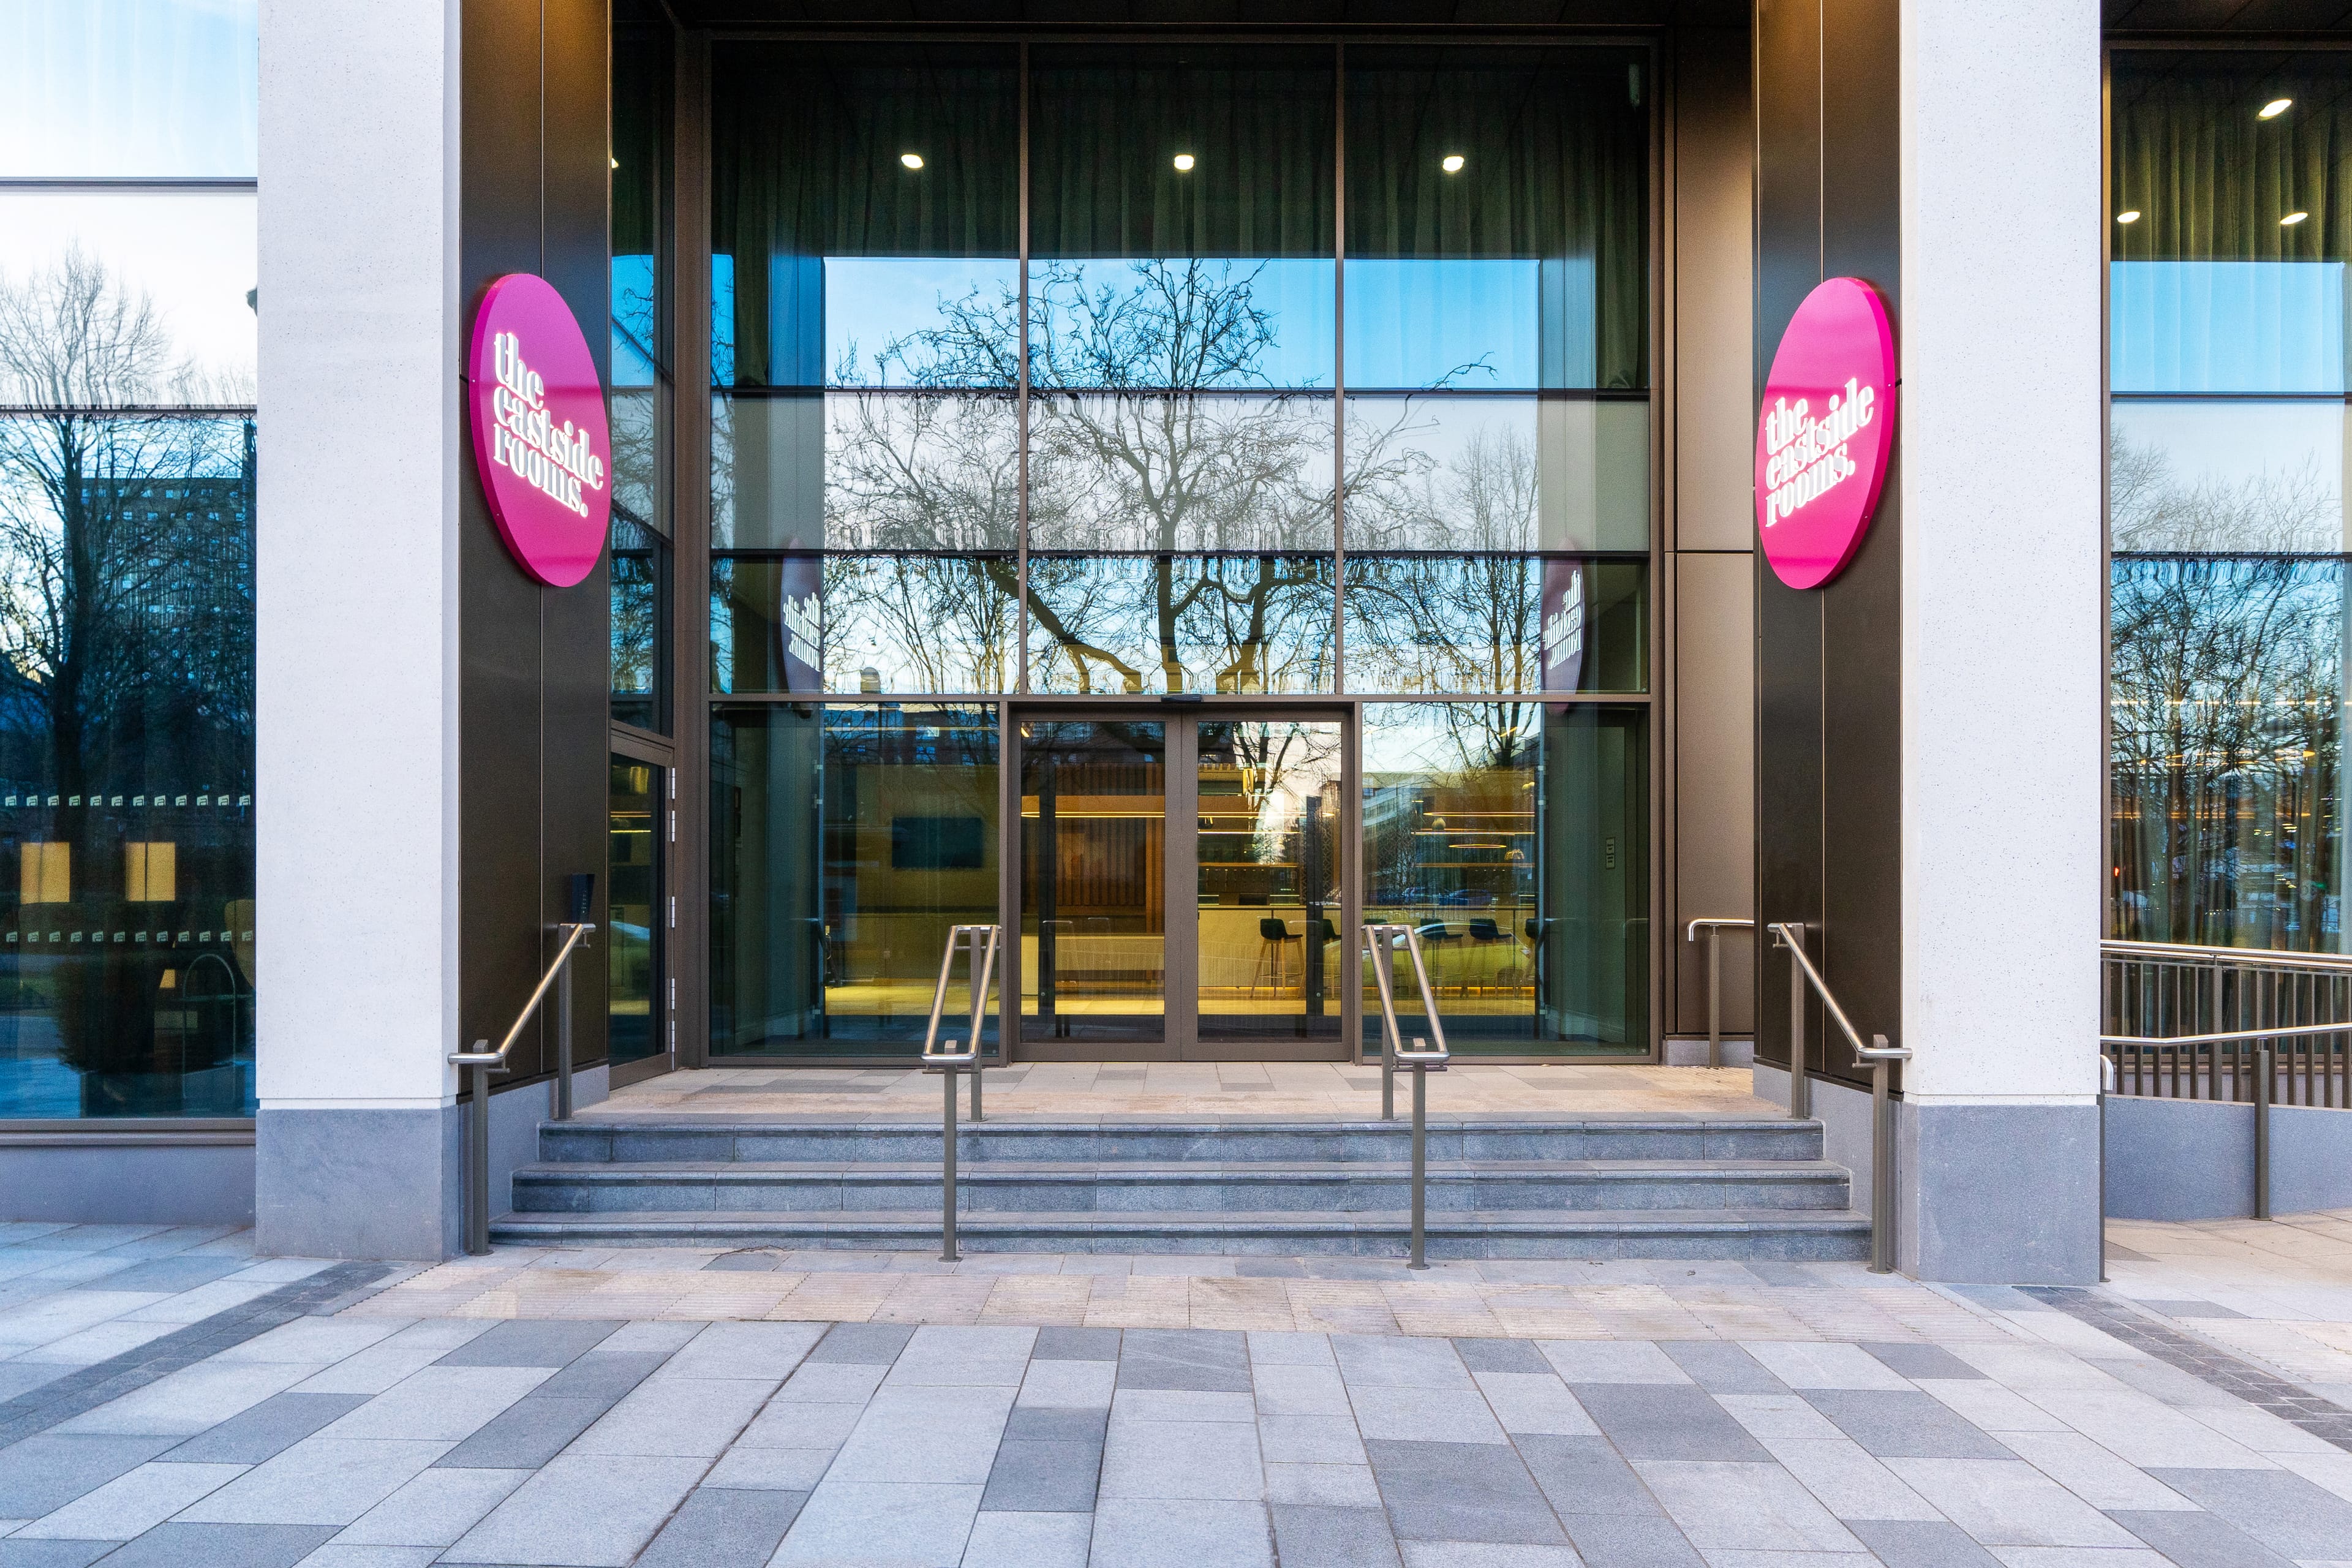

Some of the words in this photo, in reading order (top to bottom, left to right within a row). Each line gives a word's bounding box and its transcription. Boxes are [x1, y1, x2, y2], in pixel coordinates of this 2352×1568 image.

[494, 333, 545, 410] the
[493, 386, 604, 490] eastside
[493, 423, 589, 518] rooms.
[1765, 396, 1809, 456] the
[1765, 377, 1874, 491] eastside
[1765, 442, 1856, 528] rooms.
